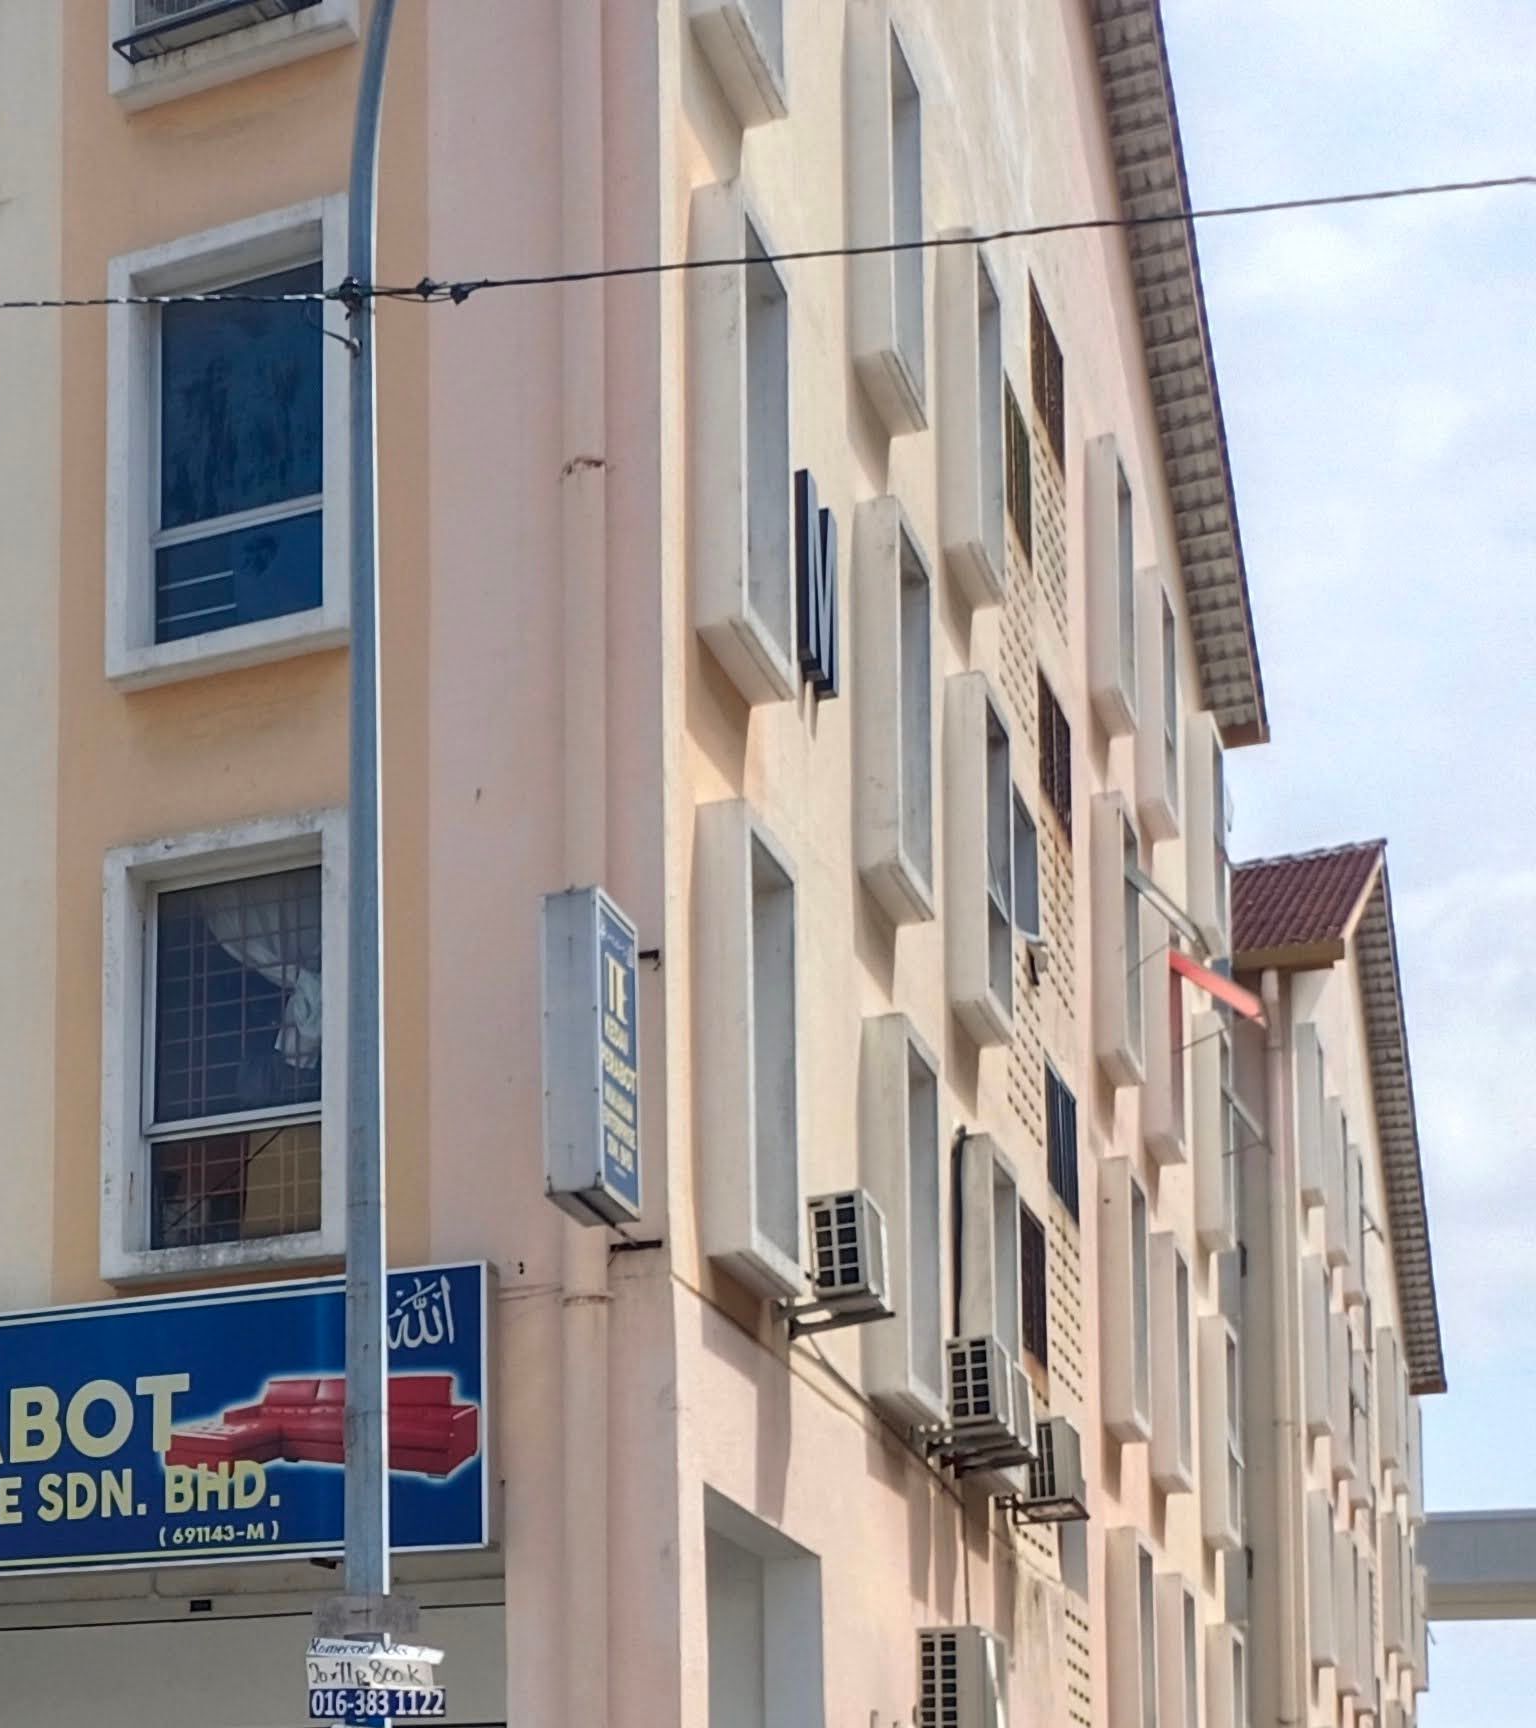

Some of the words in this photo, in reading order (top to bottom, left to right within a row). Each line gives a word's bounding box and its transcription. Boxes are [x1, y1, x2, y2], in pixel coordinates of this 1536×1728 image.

[38, 1468, 147, 1523] SDN.
[164, 1461, 281, 1514] BHD.
[311, 1690, 389, 1716] 016-383
[395, 1690, 445, 1715] 1122
